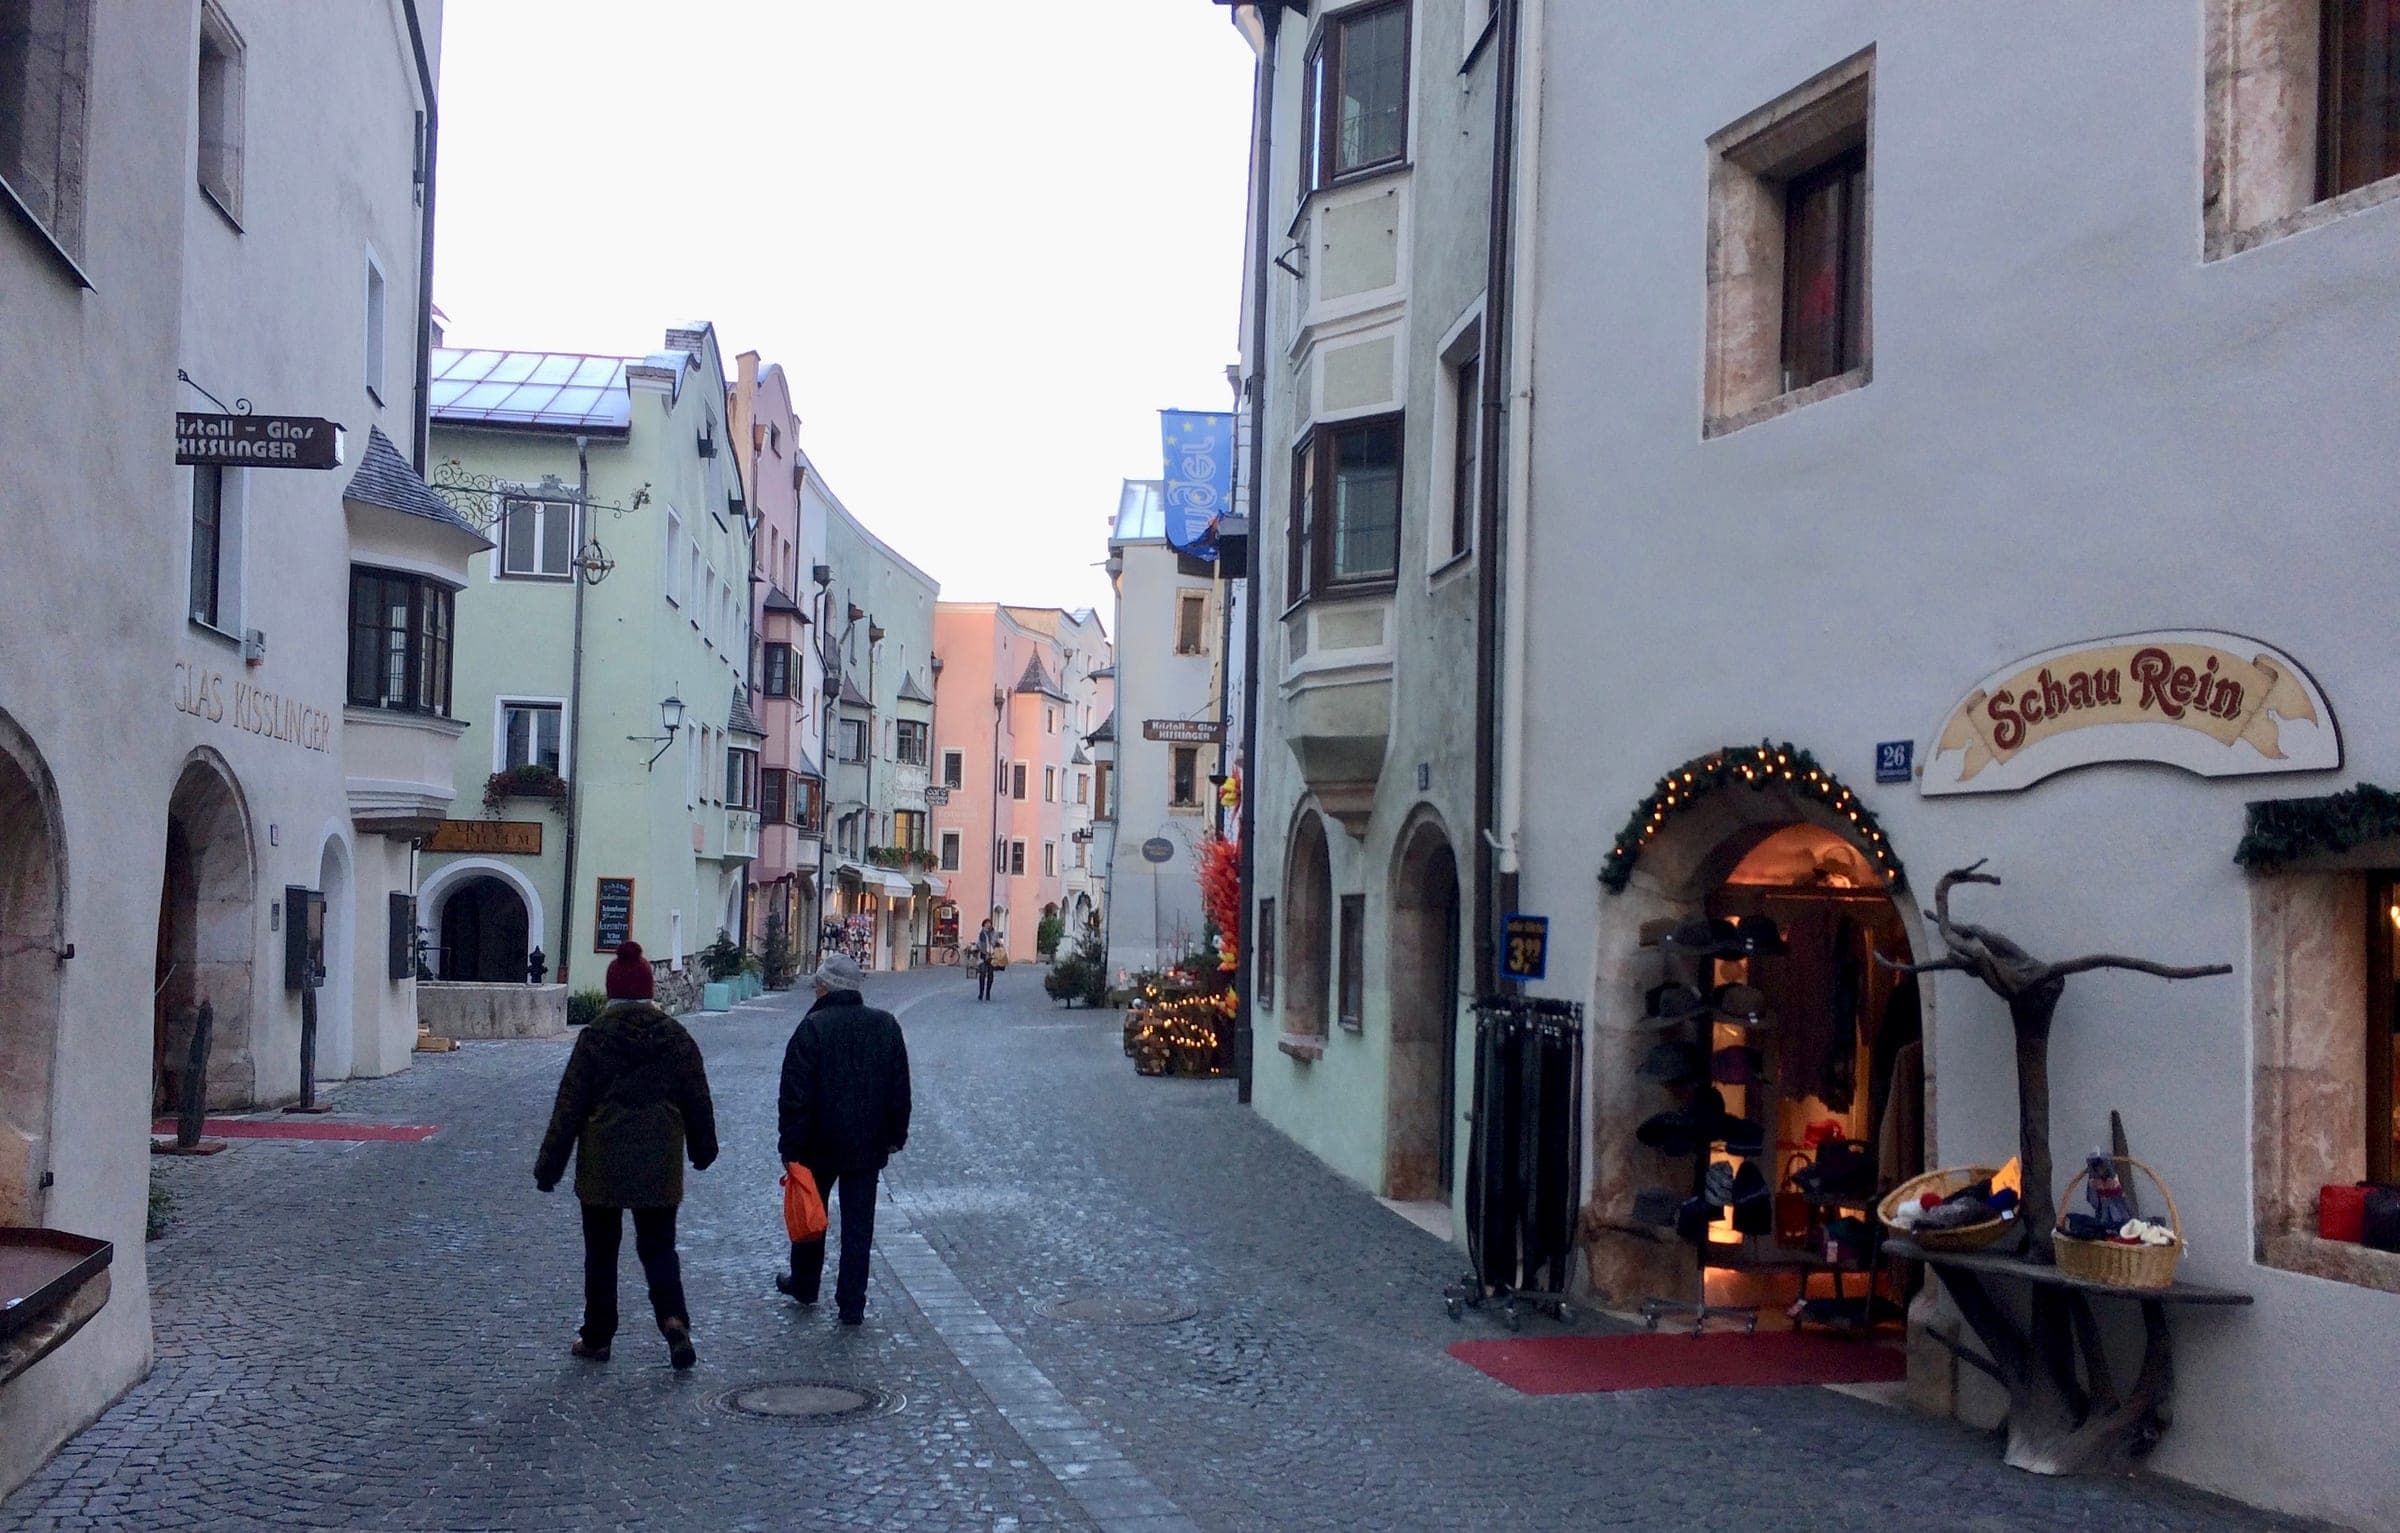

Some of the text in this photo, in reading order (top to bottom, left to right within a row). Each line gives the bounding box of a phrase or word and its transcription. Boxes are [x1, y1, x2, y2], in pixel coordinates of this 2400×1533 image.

[176, 418, 234, 437] istall
[267, 421, 314, 439] Glas
[175, 662, 330, 754] GLAS KISSLINGER
[1988, 647, 2244, 750] Schau Rein
[1883, 744, 1905, 767] 26
